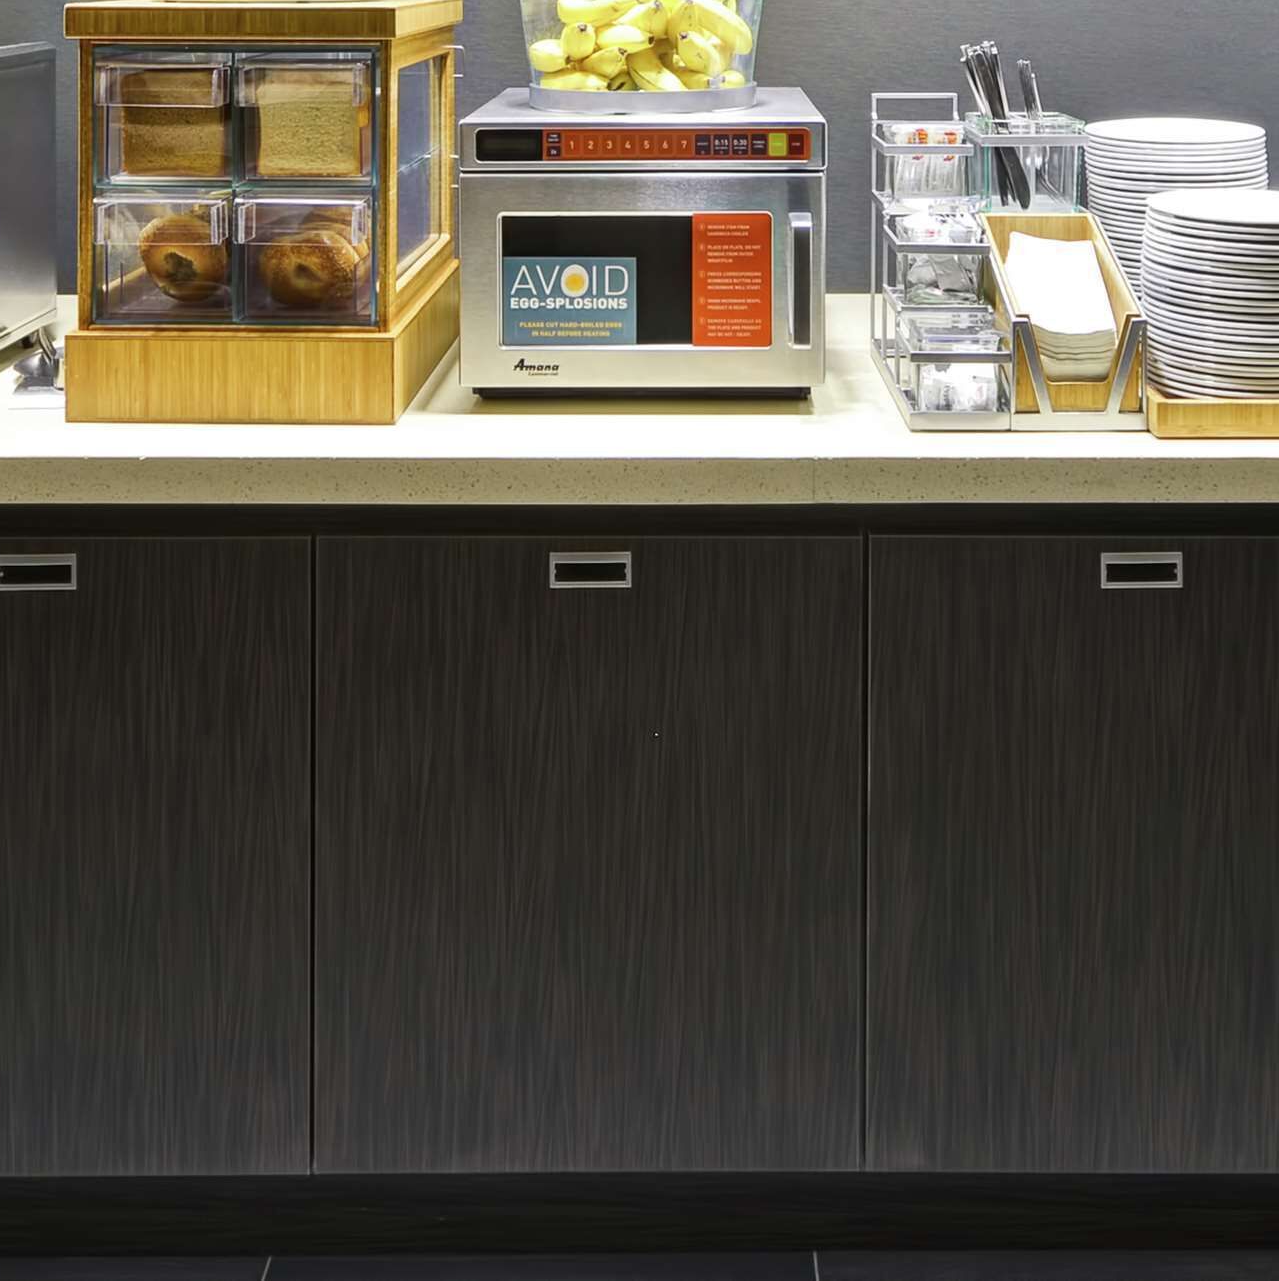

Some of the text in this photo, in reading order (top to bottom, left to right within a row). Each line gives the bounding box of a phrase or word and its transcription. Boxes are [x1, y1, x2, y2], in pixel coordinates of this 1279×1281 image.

[569, 140, 688, 150] 1 2 3 4 5 6 7
[510, 264, 629, 297] AVOID
[510, 298, 628, 310] EGG-SPLOSIONS
[512, 358, 560, 372] Amana
